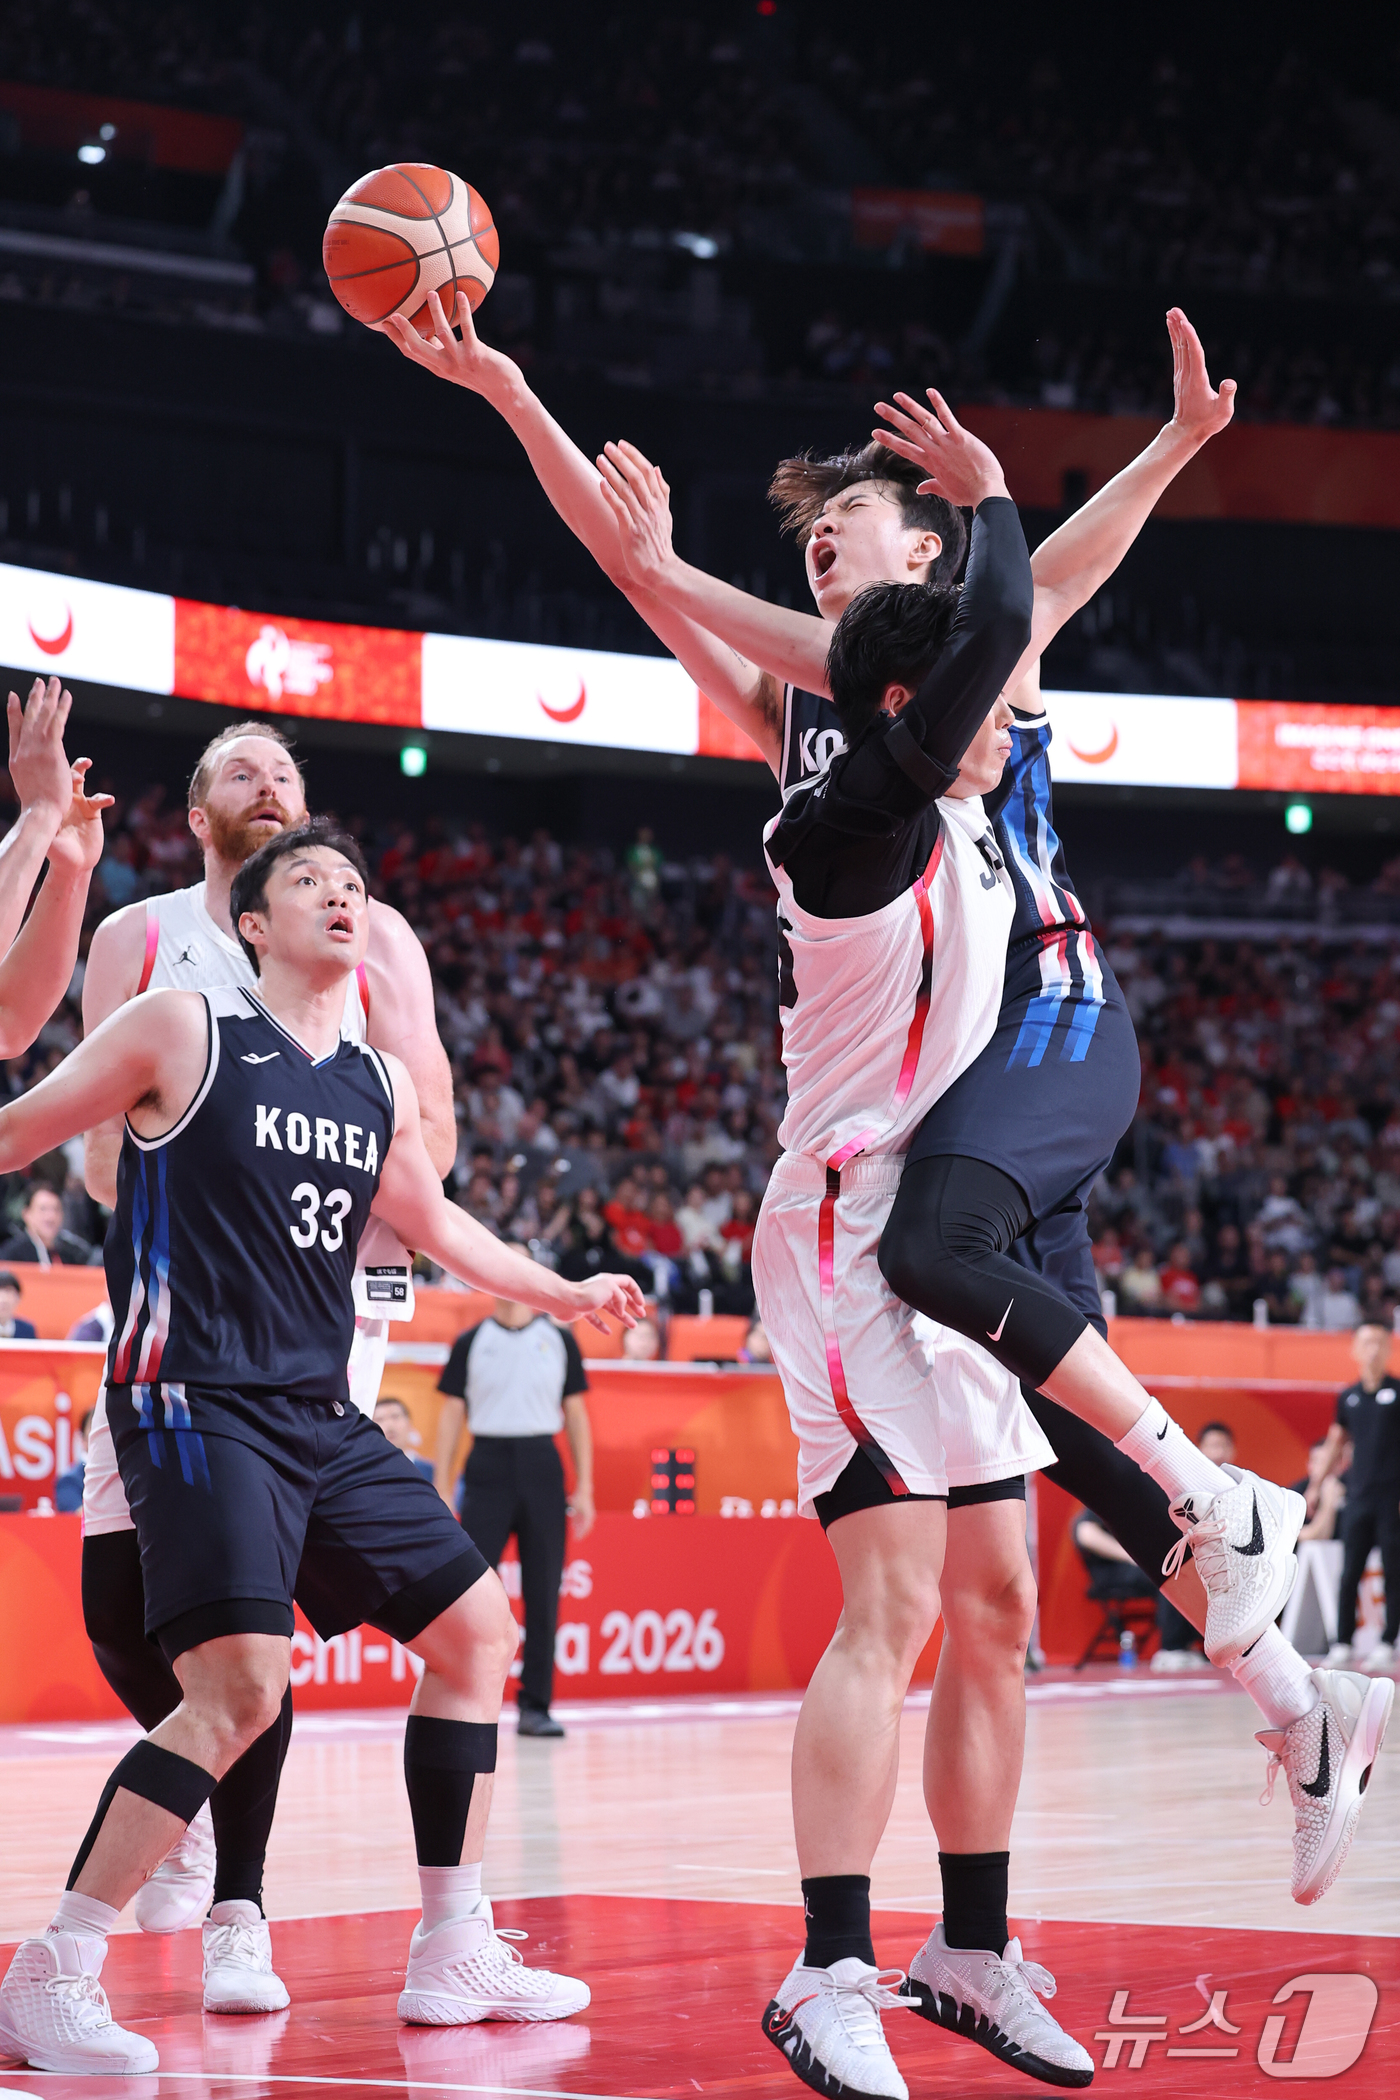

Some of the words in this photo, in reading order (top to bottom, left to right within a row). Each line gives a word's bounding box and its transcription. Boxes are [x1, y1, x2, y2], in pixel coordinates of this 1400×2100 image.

[254, 1104, 379, 1176] KOREA
[289, 1181, 353, 1253] 33
[394, 1286, 404, 1296] 58
[599, 1607, 725, 1674] 2026
